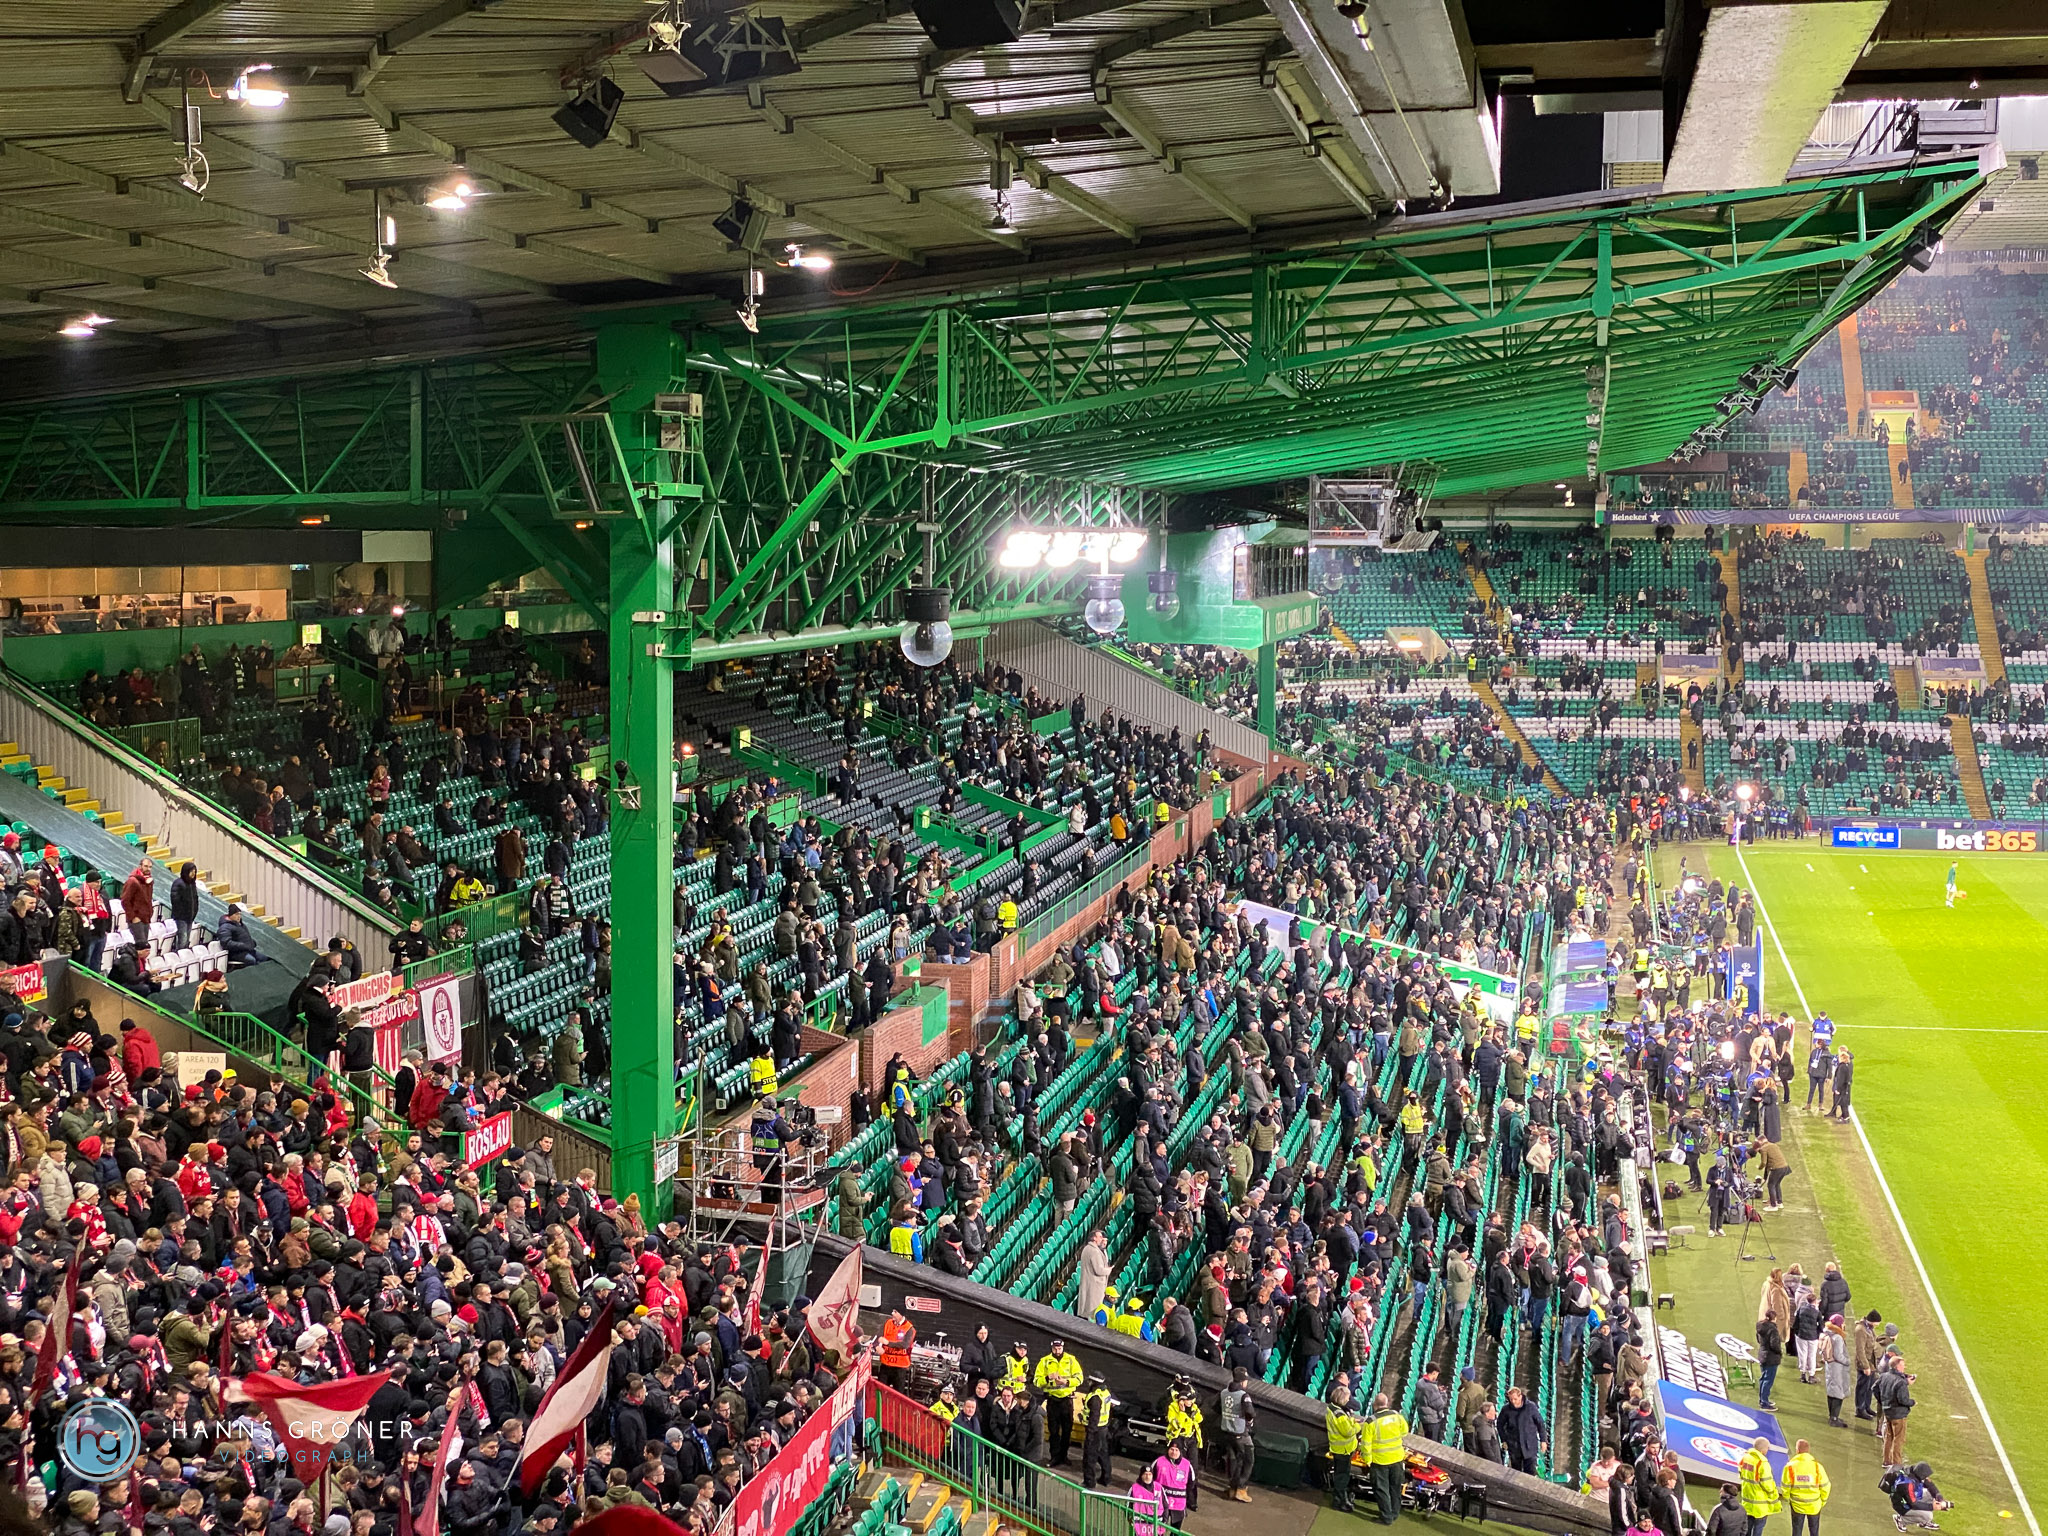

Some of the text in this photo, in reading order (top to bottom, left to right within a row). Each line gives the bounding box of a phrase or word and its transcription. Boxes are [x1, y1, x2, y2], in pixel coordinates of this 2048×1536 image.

[1612, 513, 1647, 521] Heineken
[1813, 512, 1864, 520] CHAMPIONS
[1866, 512, 1900, 520] LEAGUE
[1838, 831, 1895, 843] RECYCLE
[1937, 829, 2037, 852] bet365
[207, 1056, 219, 1064] 120
[468, 1116, 510, 1165] RÖSLAU
[1690, 1346, 1728, 1400] LEAGUE
